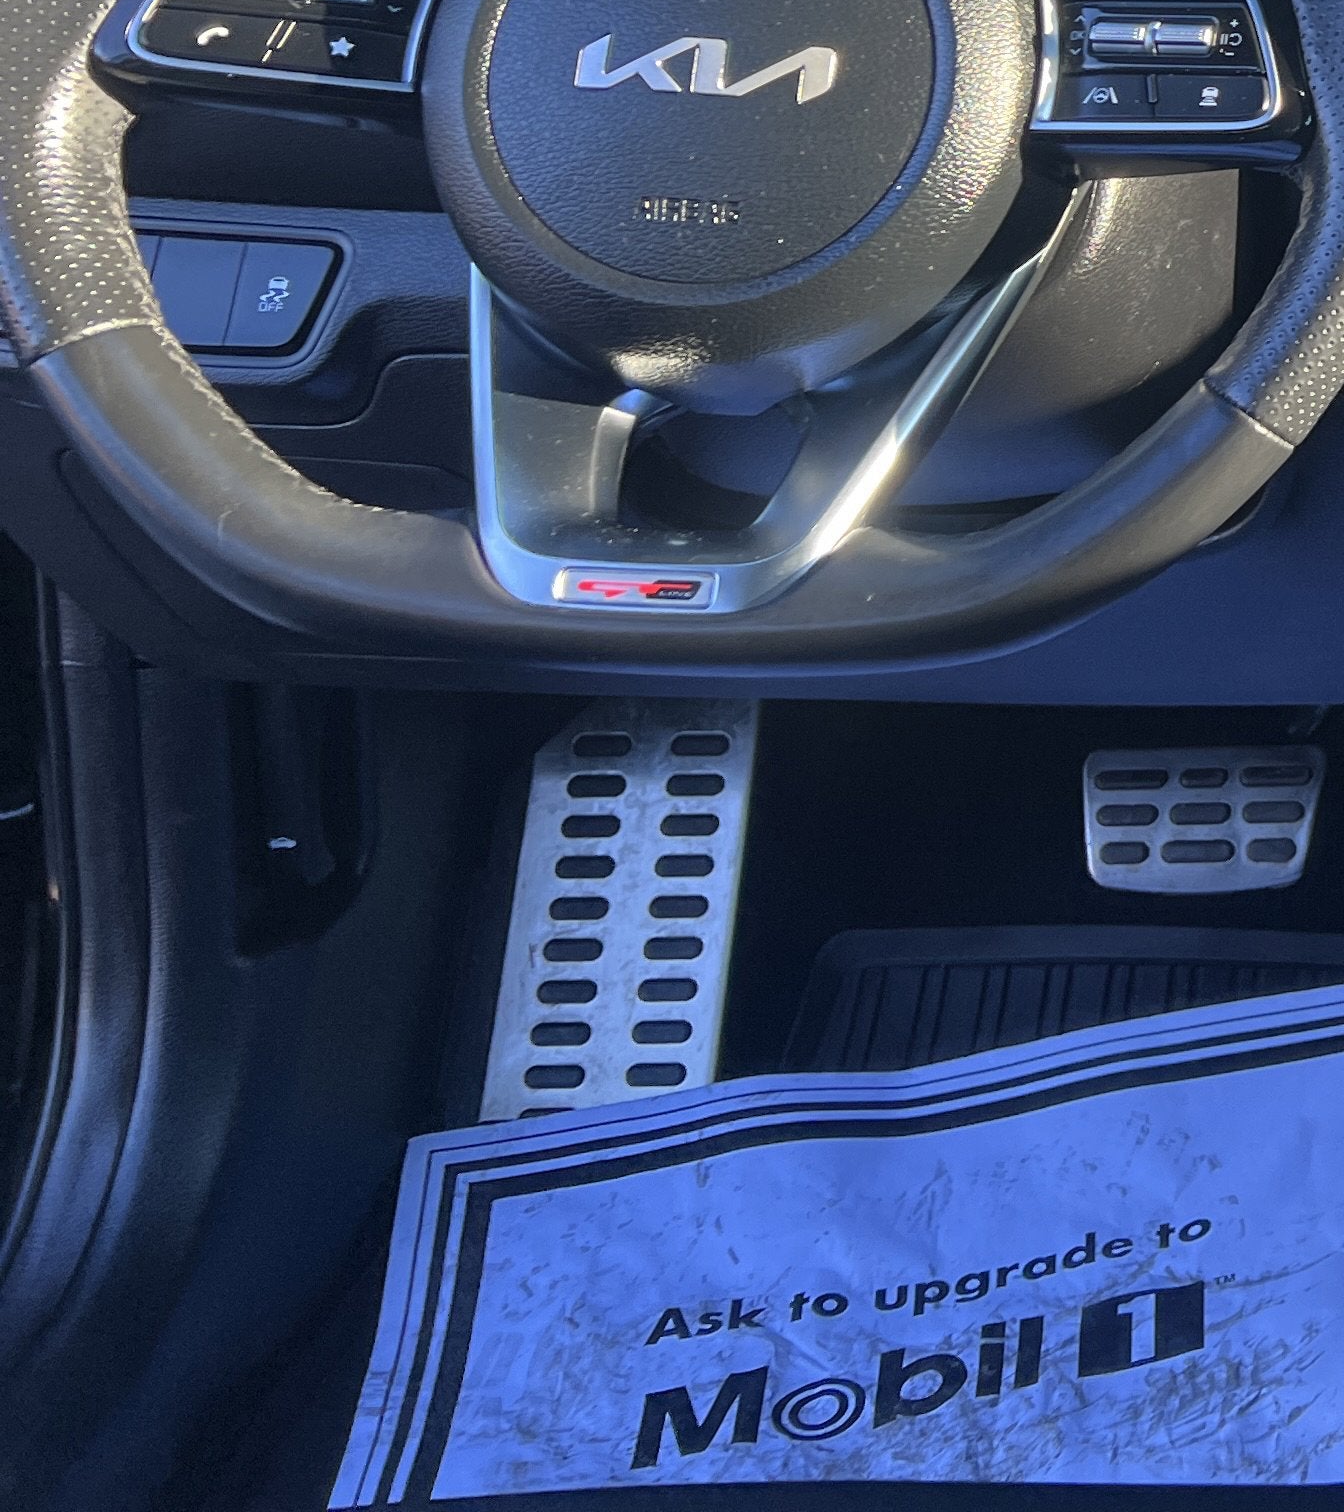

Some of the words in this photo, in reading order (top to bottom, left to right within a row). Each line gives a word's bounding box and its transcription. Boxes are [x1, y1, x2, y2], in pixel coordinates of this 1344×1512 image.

[574, 34, 838, 105] KIA
[644, 1298, 767, 1346] Ask
[789, 1291, 850, 1322] to
[874, 1232, 1134, 1318] upgrade
[1156, 1218, 1212, 1249] to
[629, 1315, 1045, 1470] Mobil
